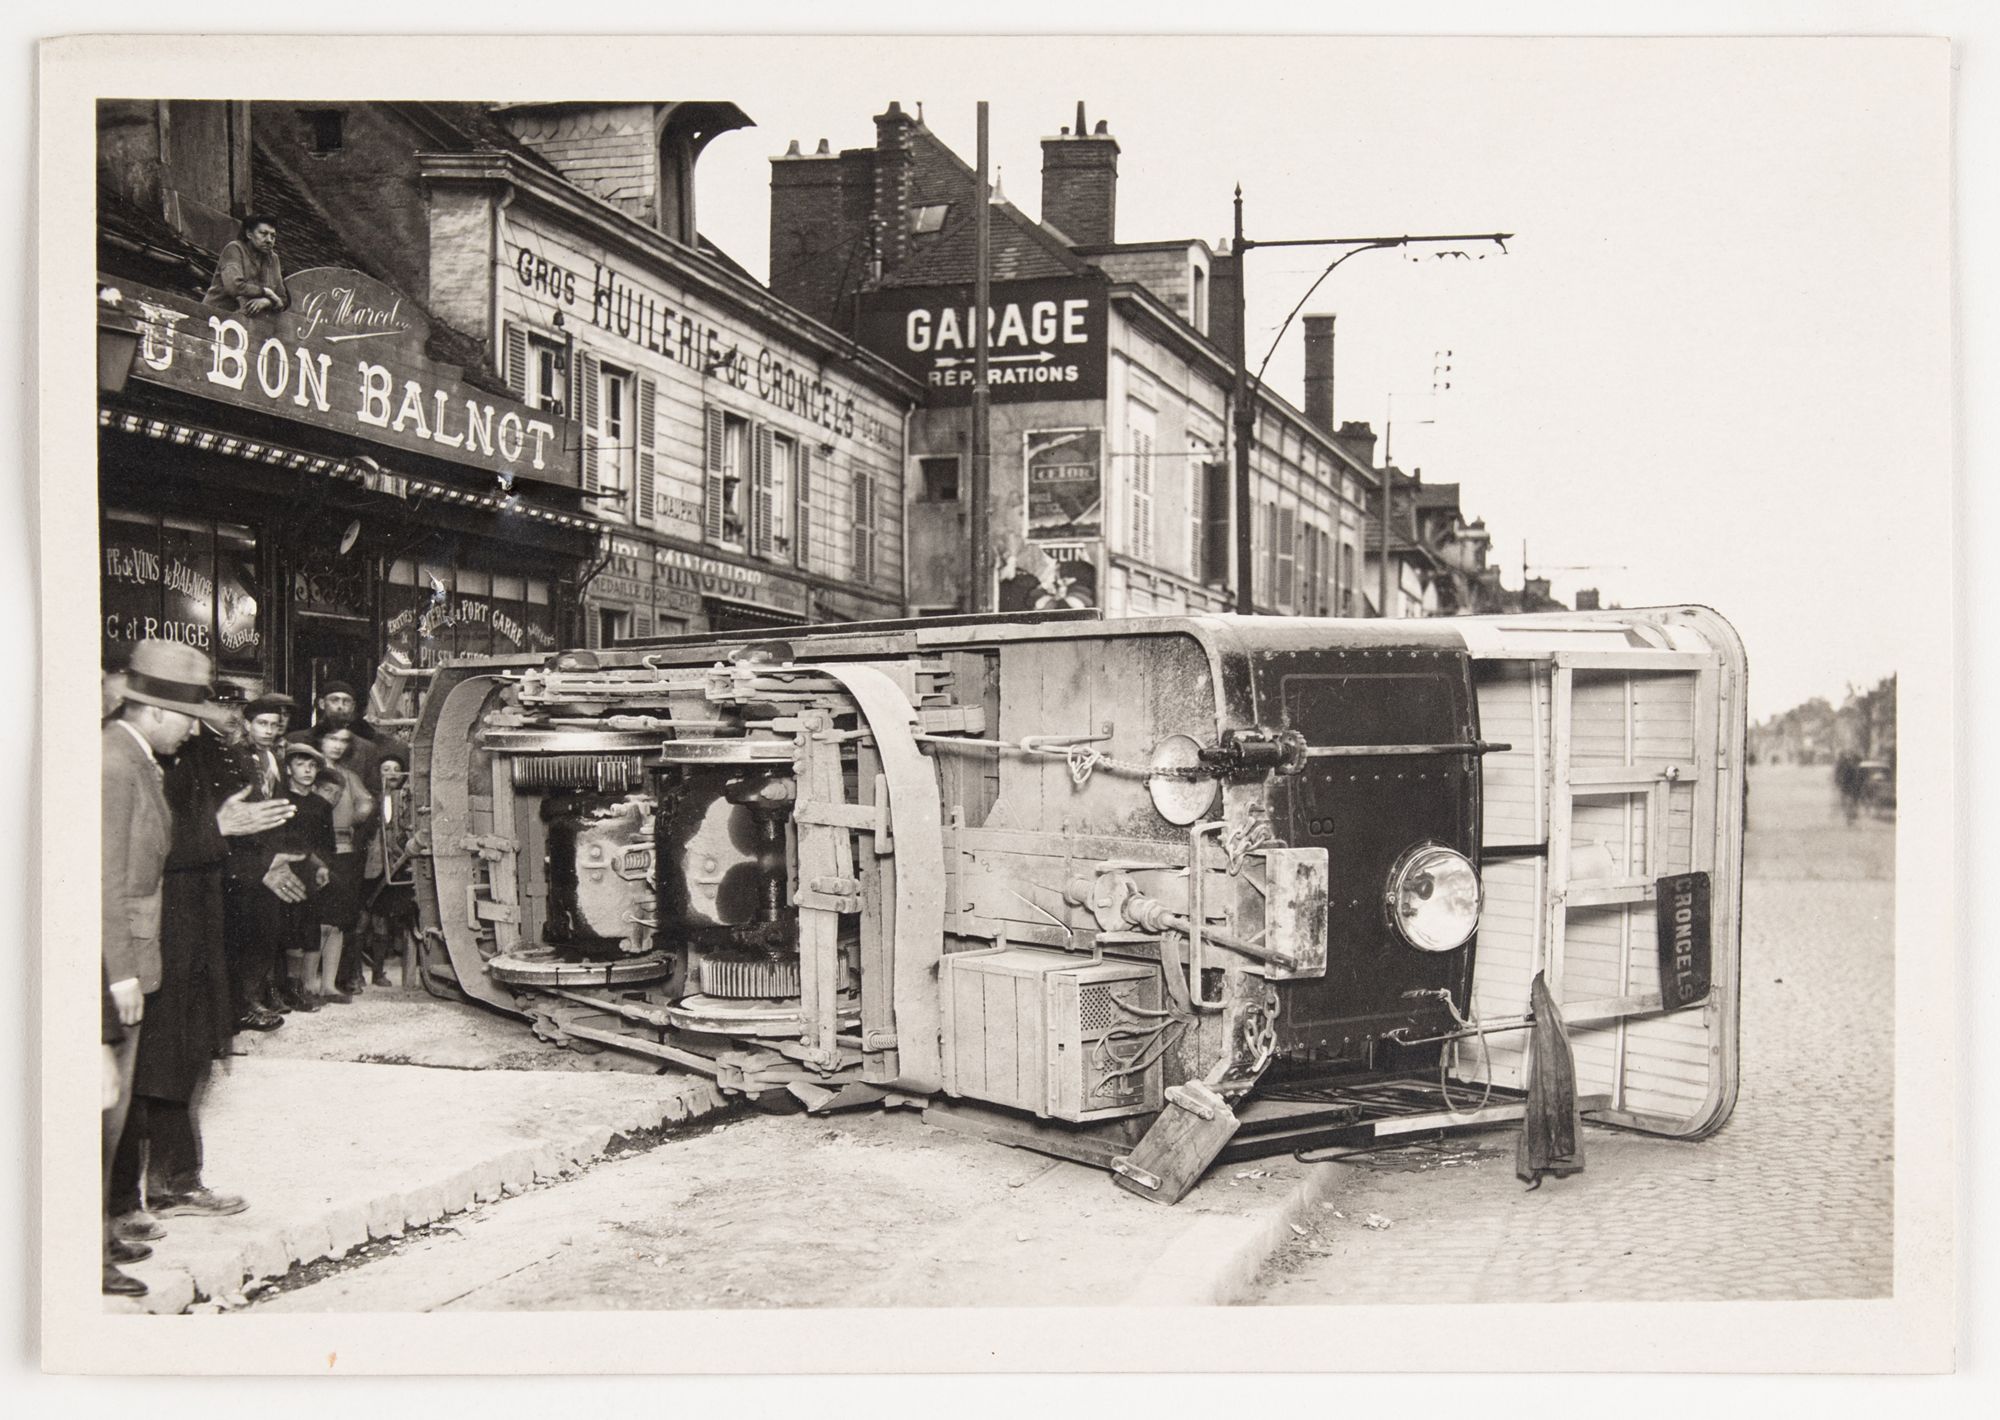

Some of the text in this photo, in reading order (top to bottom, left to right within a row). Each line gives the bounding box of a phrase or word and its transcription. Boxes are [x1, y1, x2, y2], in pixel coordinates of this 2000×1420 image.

[518, 247, 576, 306] GROS
[591, 263, 719, 378] HUILERIE
[757, 348, 854, 439] CRONCELS
[906, 299, 1089, 352] GARAGE
[206, 315, 333, 412] BON
[356, 361, 555, 470] BALNOT
[928, 365, 1079, 386] RÉPRATIONS
[131, 547, 160, 584] VINS
[144, 615, 209, 651] ROUGE
[220, 628, 260, 650] CHABLIS
[1674, 876, 1694, 1001] CRONCELS
